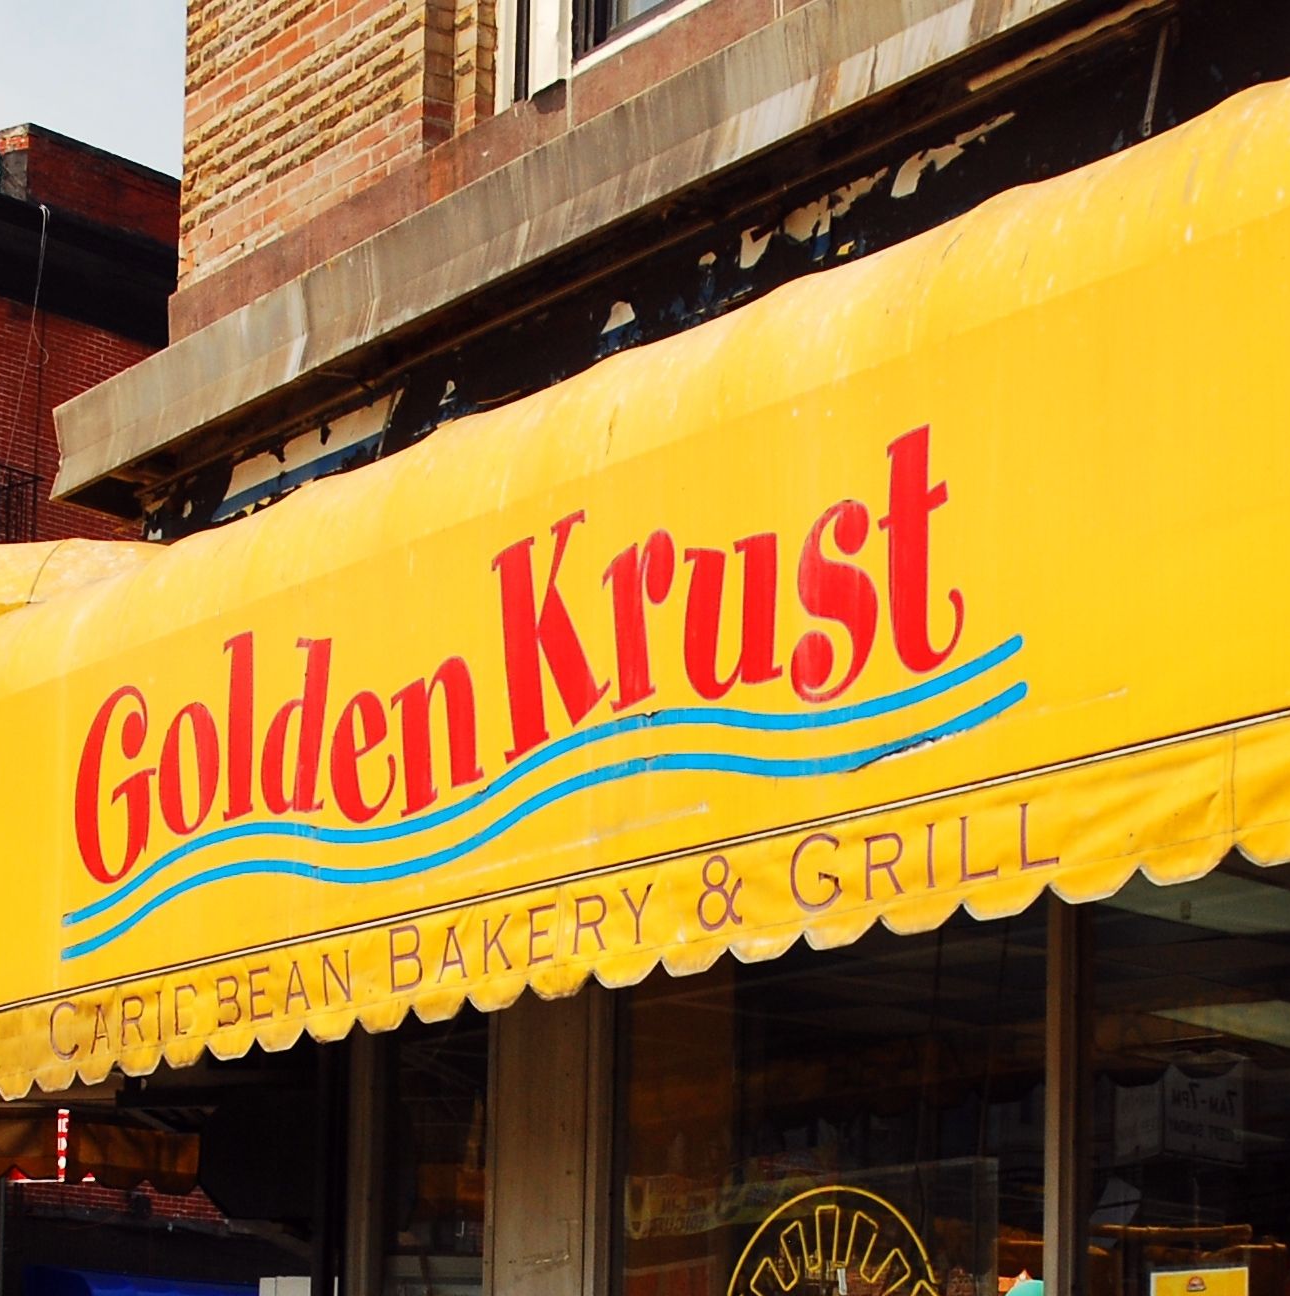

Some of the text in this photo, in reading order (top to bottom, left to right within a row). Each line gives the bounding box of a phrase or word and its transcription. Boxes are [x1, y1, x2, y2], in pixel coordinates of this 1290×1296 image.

[75, 423, 965, 883] Golden Krust
[388, 883, 654, 994] BAKERY
[697, 854, 743, 931] &
[790, 803, 1060, 913] GRILL
